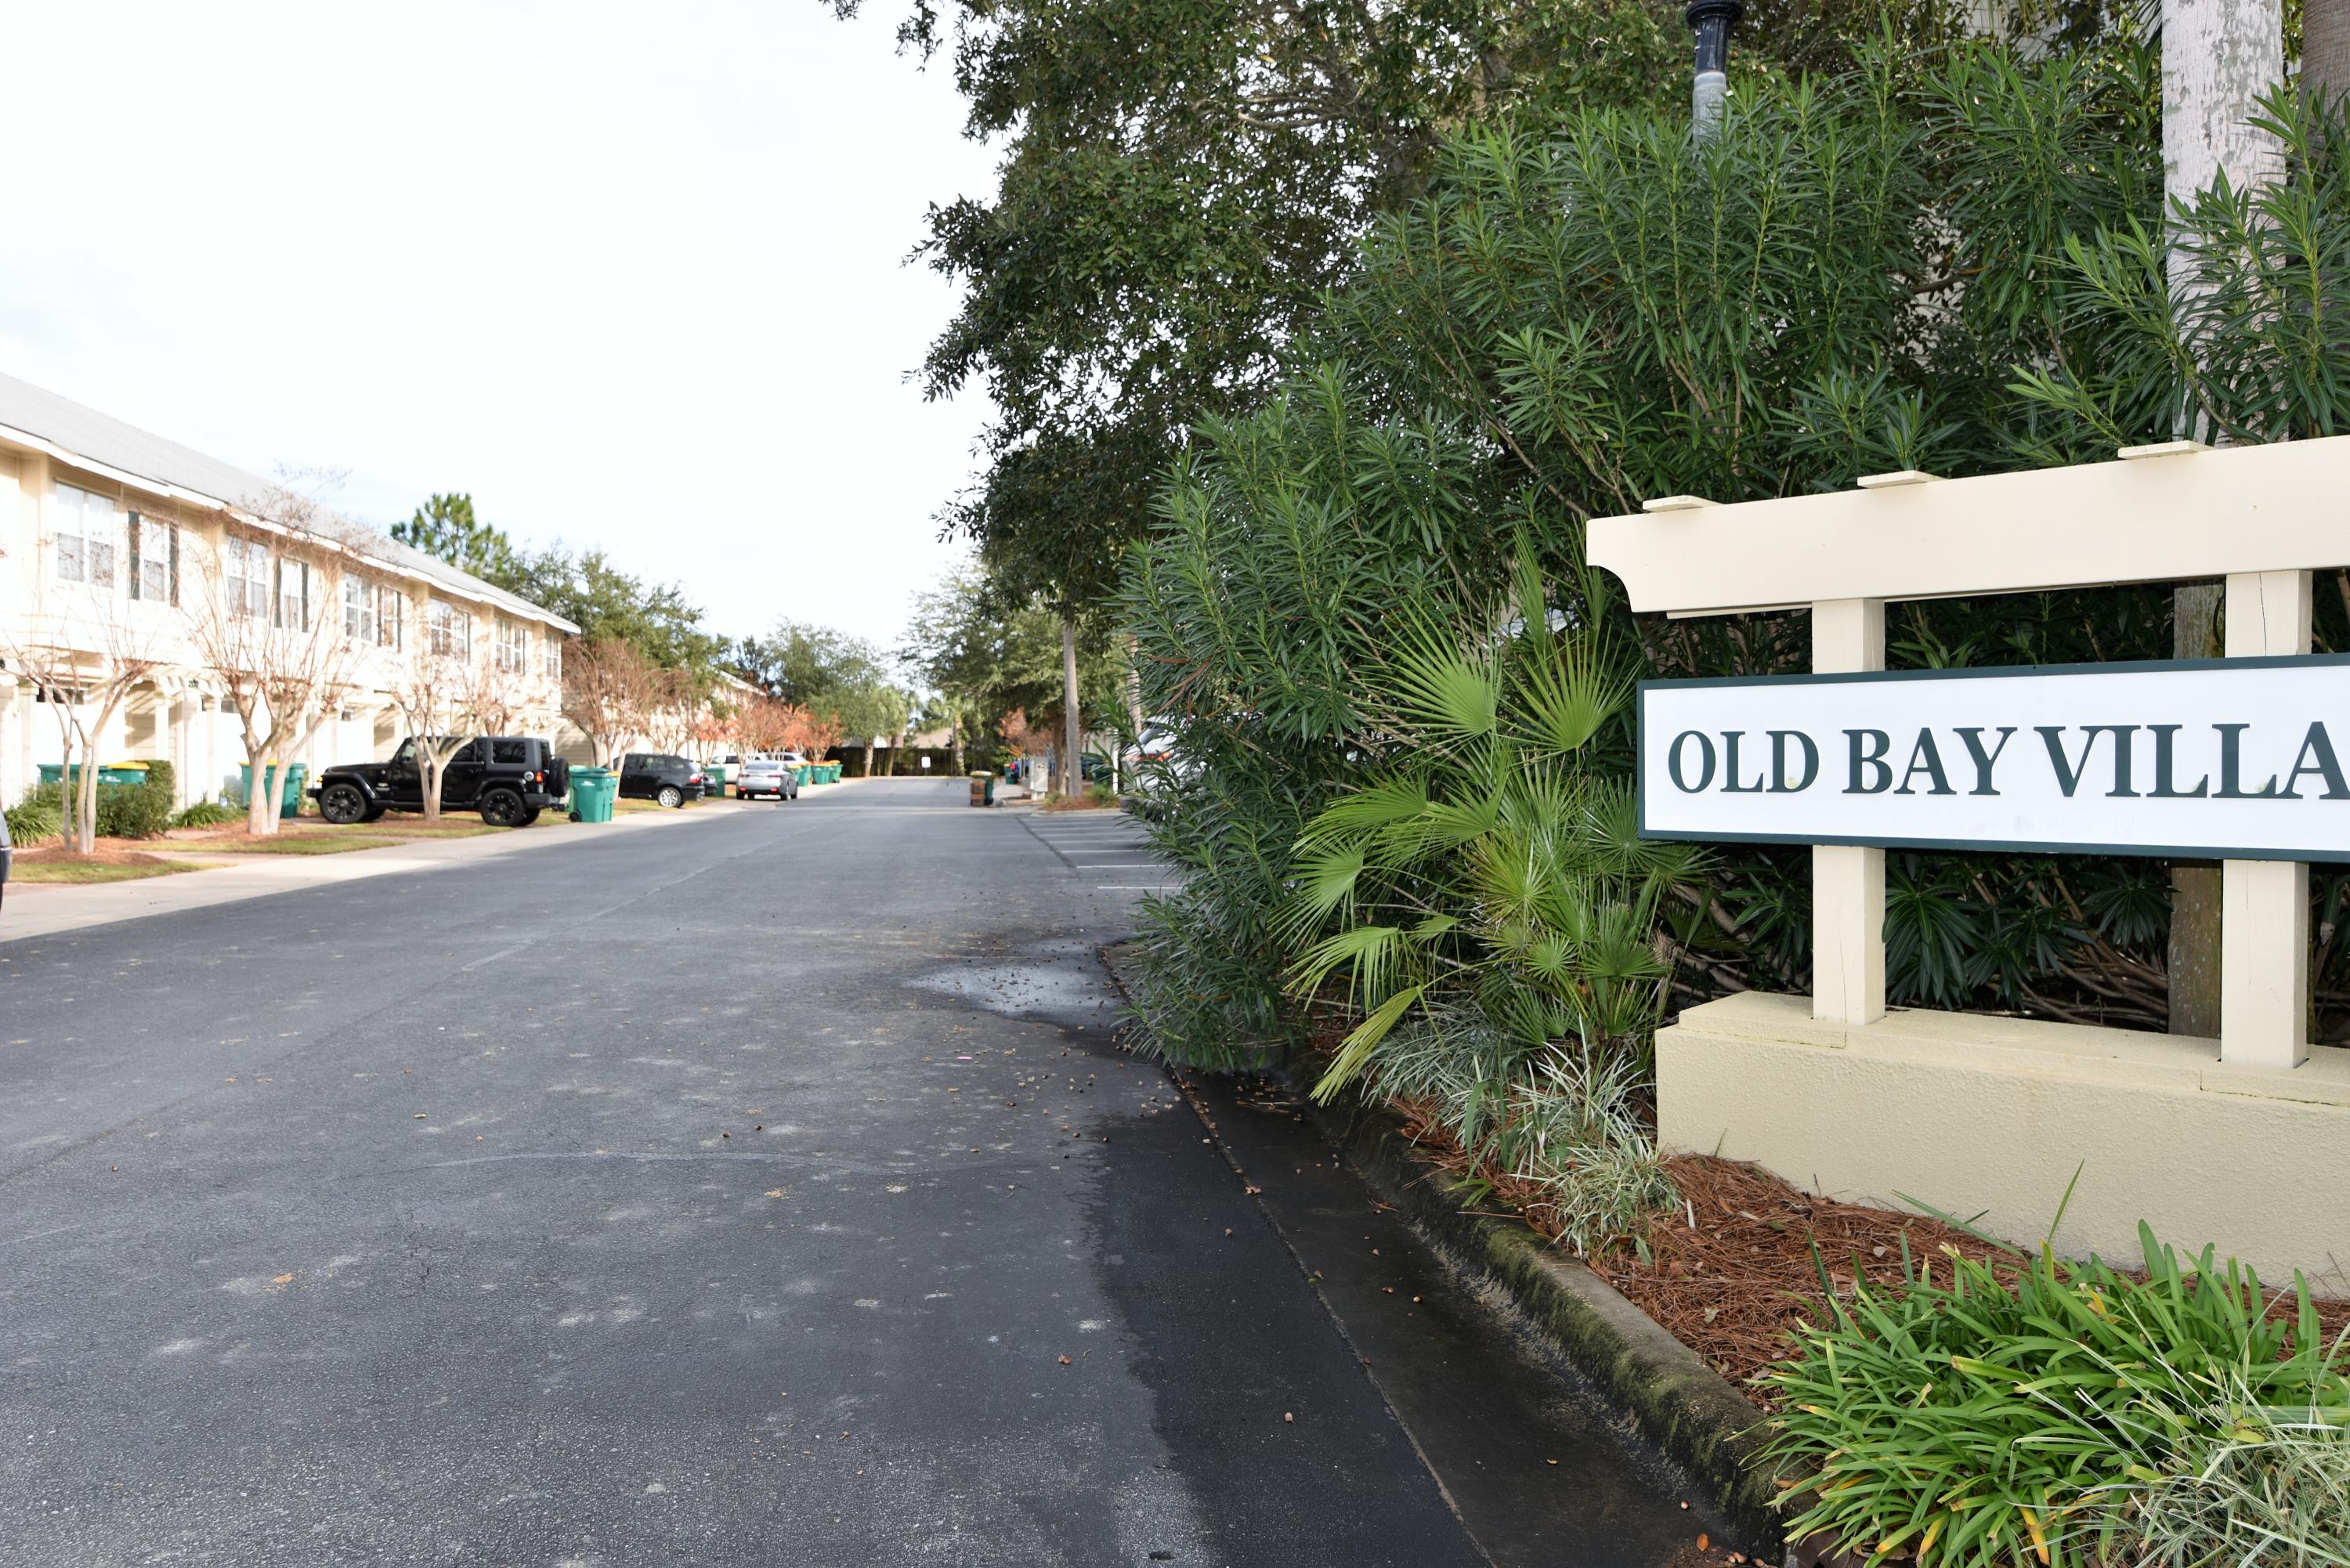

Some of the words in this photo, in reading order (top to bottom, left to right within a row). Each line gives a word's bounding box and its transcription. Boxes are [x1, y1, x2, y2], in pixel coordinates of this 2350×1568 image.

[1668, 730, 1820, 793] OLD
[1842, 727, 2018, 796] BAY
[2033, 721, 2350, 800] VILLA
